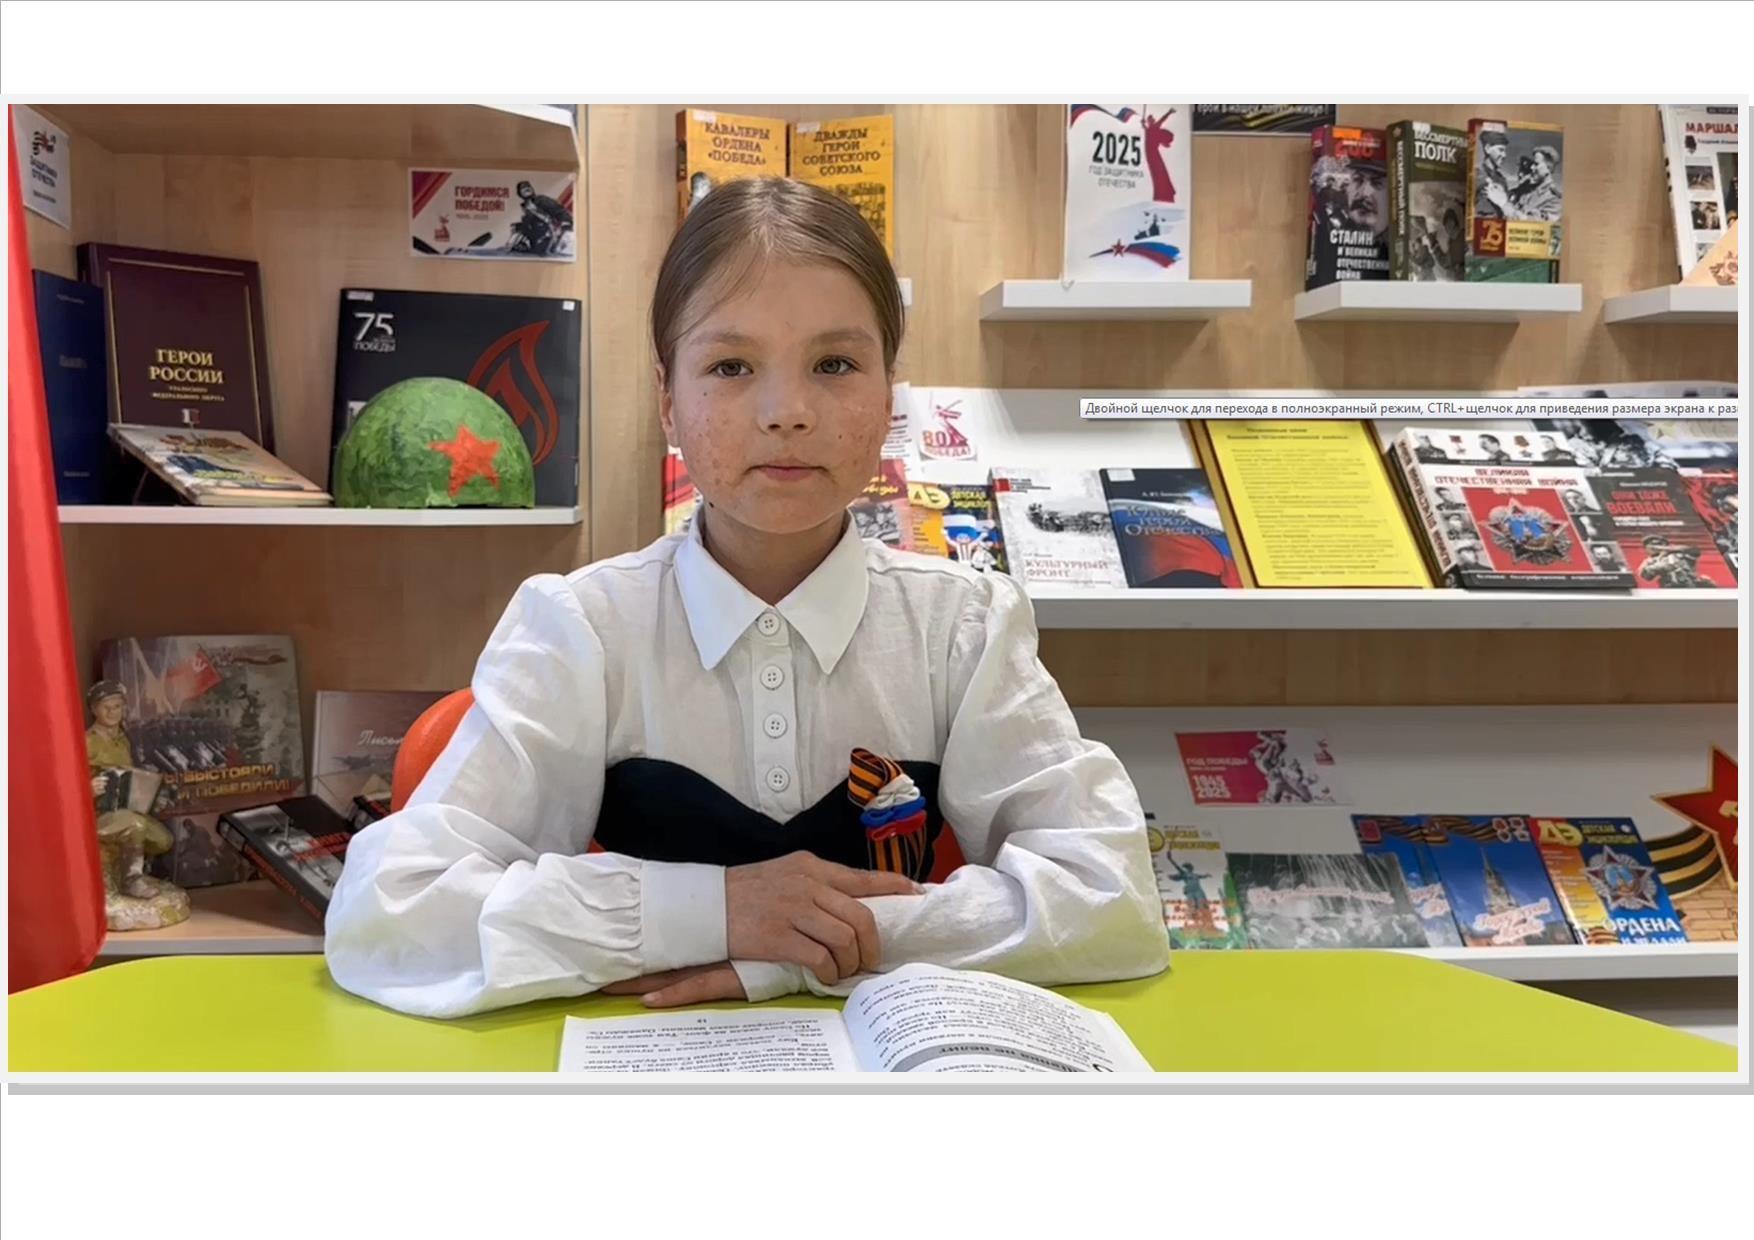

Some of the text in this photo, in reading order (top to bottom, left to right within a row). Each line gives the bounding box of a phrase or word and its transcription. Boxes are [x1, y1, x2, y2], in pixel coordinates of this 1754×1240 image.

[705, 122, 770, 141] КАВАЛЕРЫ
[814, 128, 868, 143] ДВАЖДЫ
[712, 136, 762, 153] ОРДЕНА
[822, 142, 860, 153] ГЕРОИ
[1092, 131, 1141, 166] 2025
[1414, 140, 1457, 163] ПОЛК
[707, 151, 767, 166] «ПОБЕДА»
[802, 151, 881, 166] СОВЕТСКОГО
[819, 164, 863, 177] СОЮЗА
[454, 186, 510, 198] ГОРДИМСЯ
[454, 199, 505, 212] ПОБЕДОЙ!
[1330, 229, 1374, 246] СТАЛИН
[1337, 246, 1378, 258] И ВЕЛИКАЯ
[1335, 268, 1361, 280] ВОЙНА
[353, 312, 394, 341] 75
[157, 348, 214, 367] ГЕРОИ
[149, 366, 224, 385] РОССИИ
[1475, 468, 1530, 476] ВЕЛИКАЯ
[1434, 477, 1579, 487] ОТЕЧЕСТВЕННАЯ ВОЙНА
[1605, 502, 1677, 514] ВОЕВАЛИ
[1025, 559, 1108, 570] КУЛЬТУРНЫЙ
[1026, 569, 1070, 577] ФРОНТ
[1207, 757, 1249, 767] ПОБЕДЫ
[182, 764, 275, 784] ВЫСТОЯЛИ
[195, 780, 291, 798] ПОБЕДИЛИ!
[1192, 775, 1226, 789] 1945
[1537, 820, 1583, 846] ДЭ
[1602, 917, 1680, 937] ОРДЕНА
